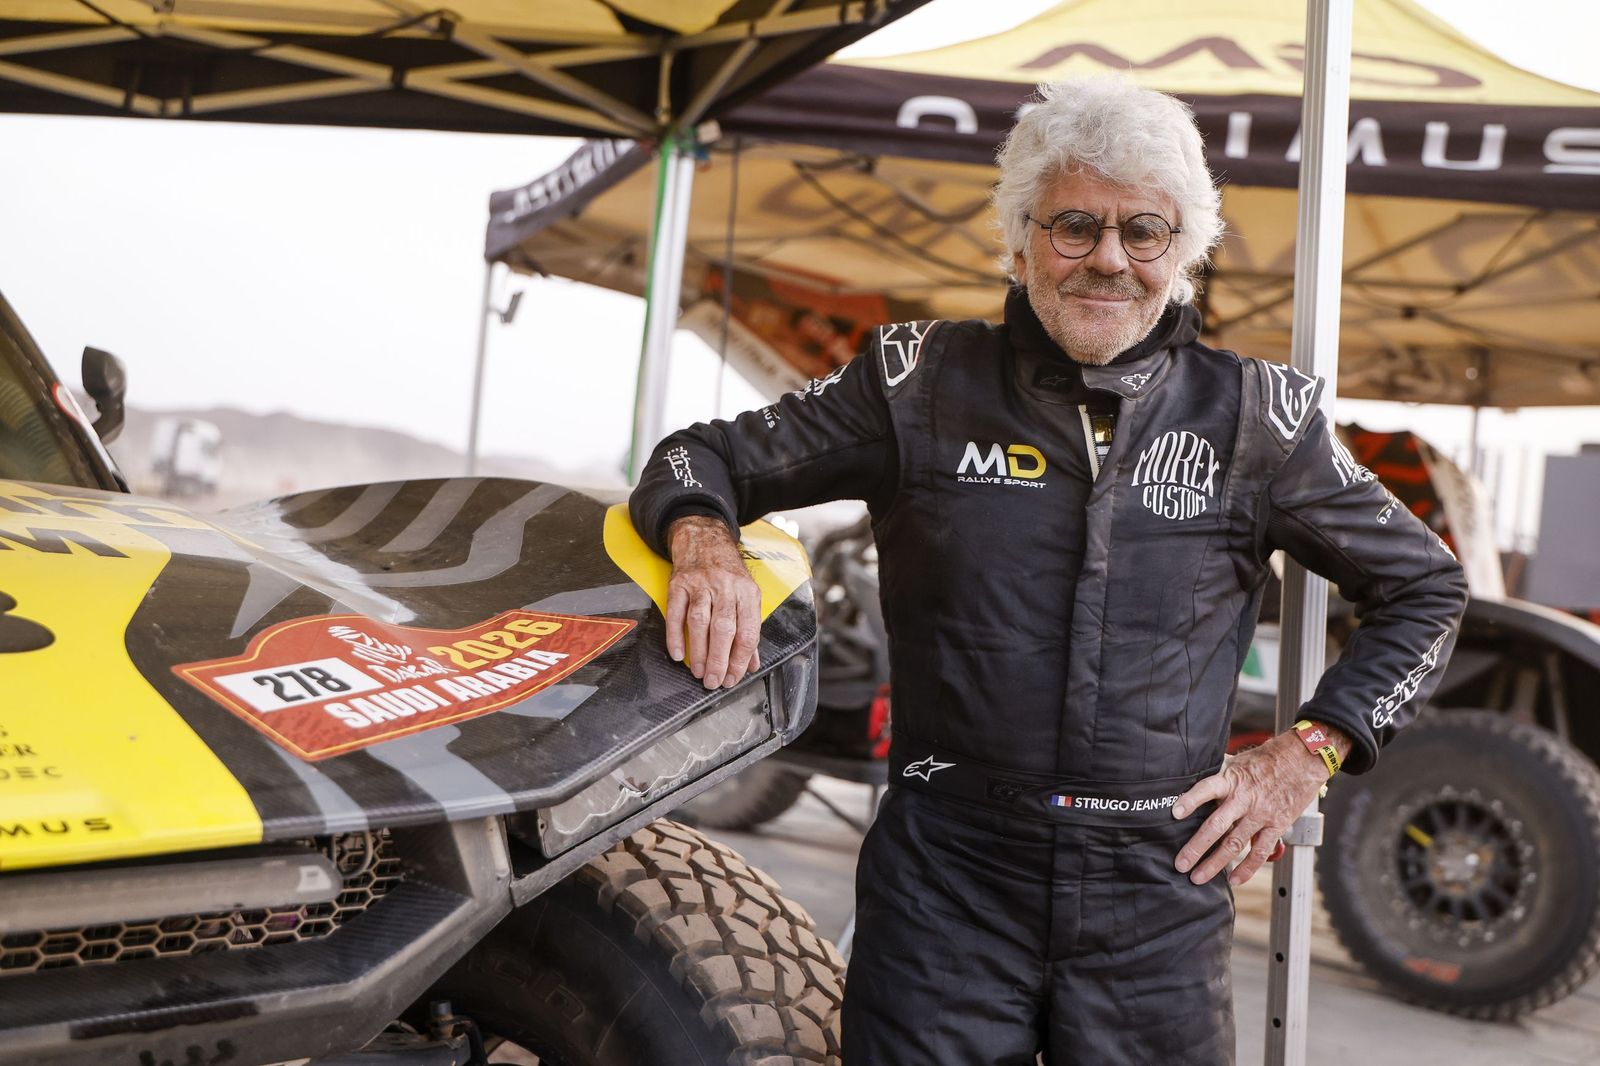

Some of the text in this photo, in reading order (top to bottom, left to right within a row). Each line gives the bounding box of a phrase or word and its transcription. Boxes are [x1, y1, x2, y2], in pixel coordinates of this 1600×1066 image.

[956, 440, 1047, 479] MD
[1131, 430, 1221, 498] MOREX
[957, 475, 1047, 489] RALLYE SPORT
[1142, 484, 1208, 521] CUSTOM
[426, 617, 563, 671] 2026
[252, 665, 353, 703] 278
[322, 648, 571, 730] SAUDI ARABIA
[1074, 796, 1131, 812] STRUGO
